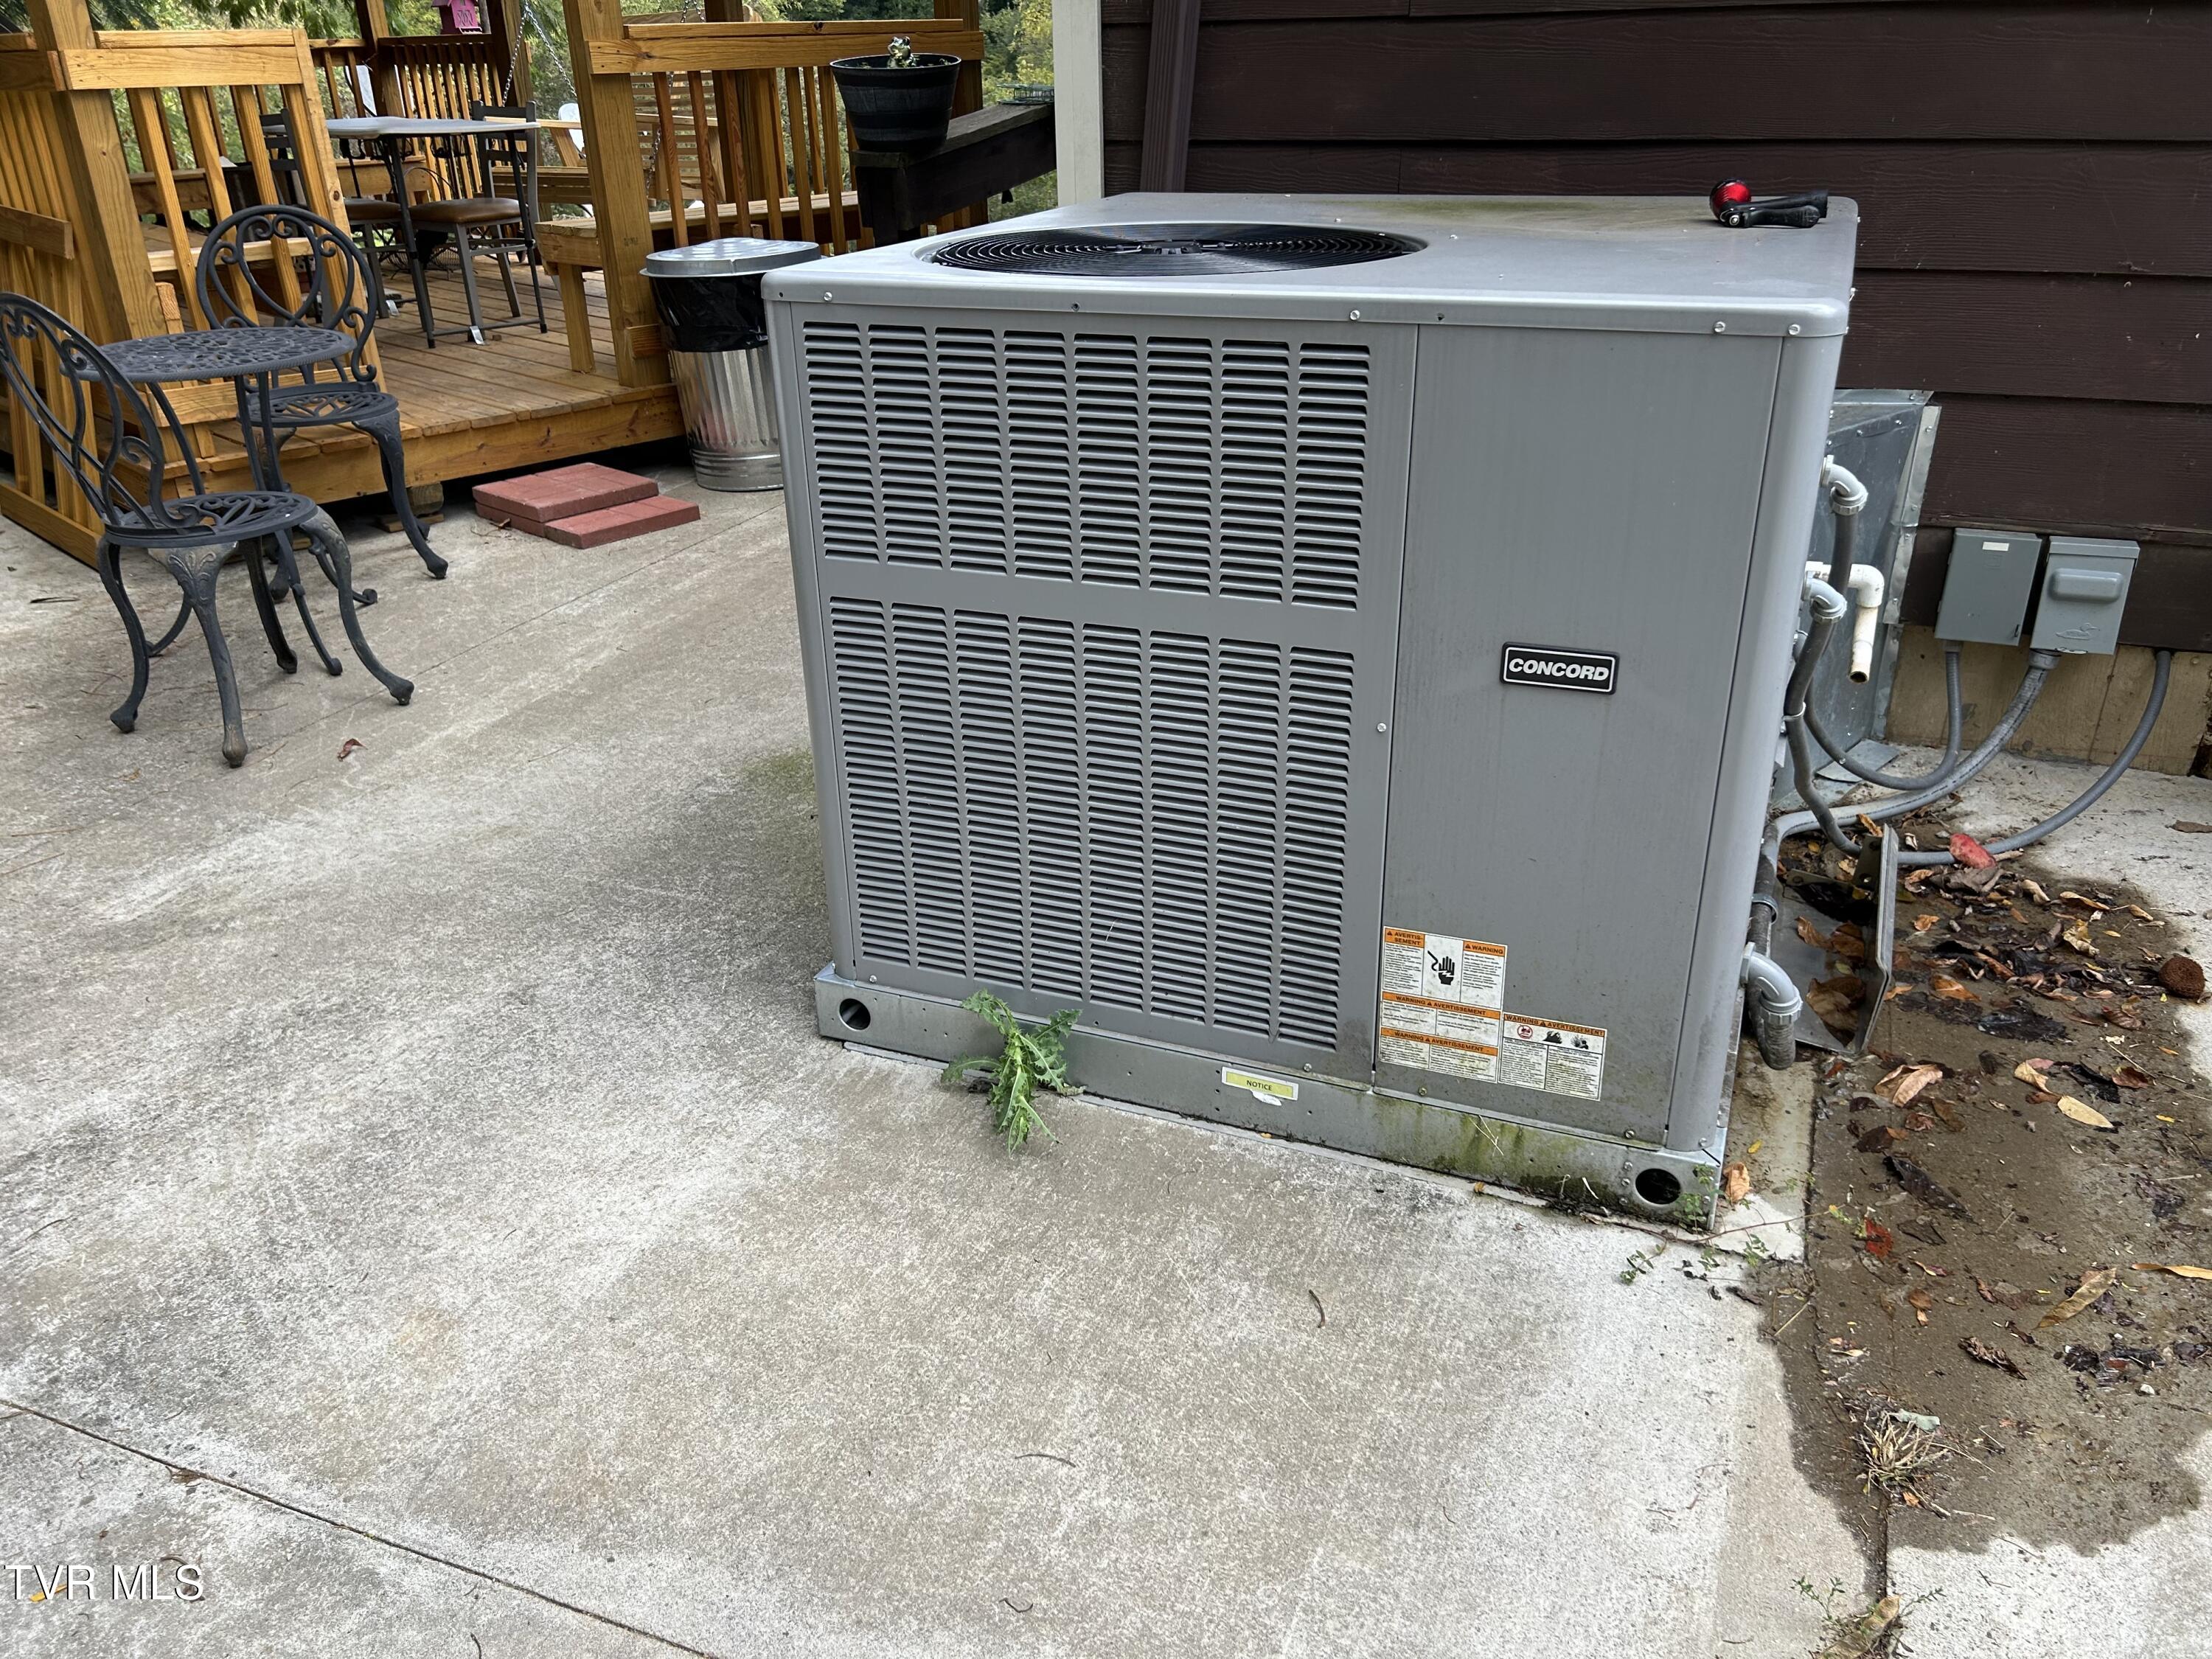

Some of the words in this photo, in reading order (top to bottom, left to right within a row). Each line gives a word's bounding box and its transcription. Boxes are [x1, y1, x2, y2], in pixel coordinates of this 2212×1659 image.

[1509, 658, 1609, 681] CONCORD
[1394, 931, 1423, 940] AVERTIS-
[1394, 937, 1422, 946] SEMENT
[1472, 945, 1503, 954] WARNING
[1396, 995, 1426, 1005] WARNING
[1433, 1002, 1486, 1015] AVERTISSEMENT
[1506, 1014, 1539, 1025] WARNING
[1548, 1021, 1603, 1036] AVERTISSEMENT
[1394, 1031, 1425, 1041] WARNING
[1431, 1038, 1484, 1051] AVERTISSEMENT
[1247, 1080, 1273, 1091] NOTICE
